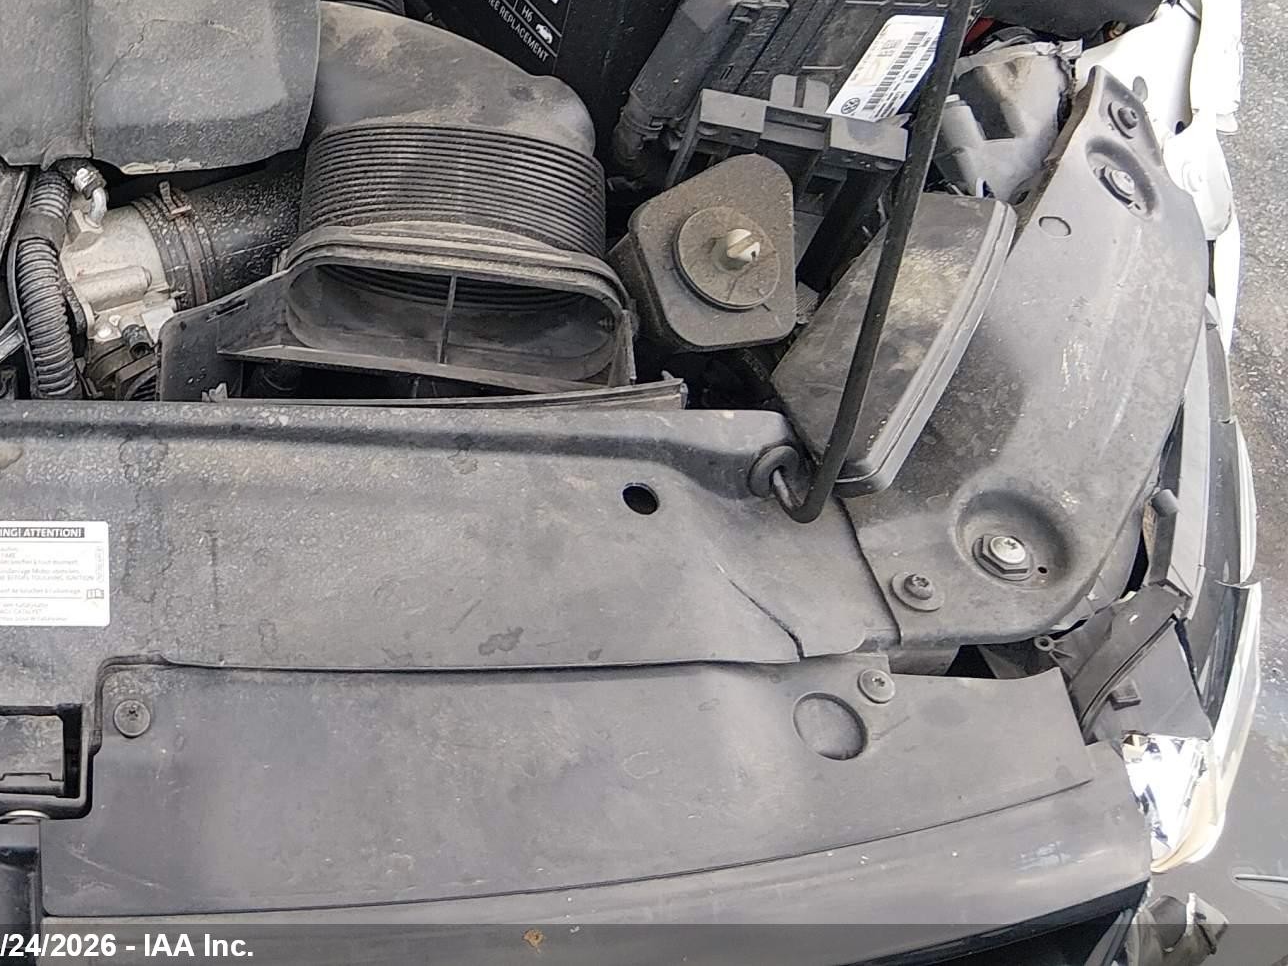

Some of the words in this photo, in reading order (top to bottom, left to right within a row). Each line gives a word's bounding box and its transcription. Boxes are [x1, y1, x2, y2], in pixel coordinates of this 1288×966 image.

[521, 4, 533, 22] H6
[498, 5, 550, 62] REPLACEMENT
[23, 528, 82, 537] ATTENTION!
